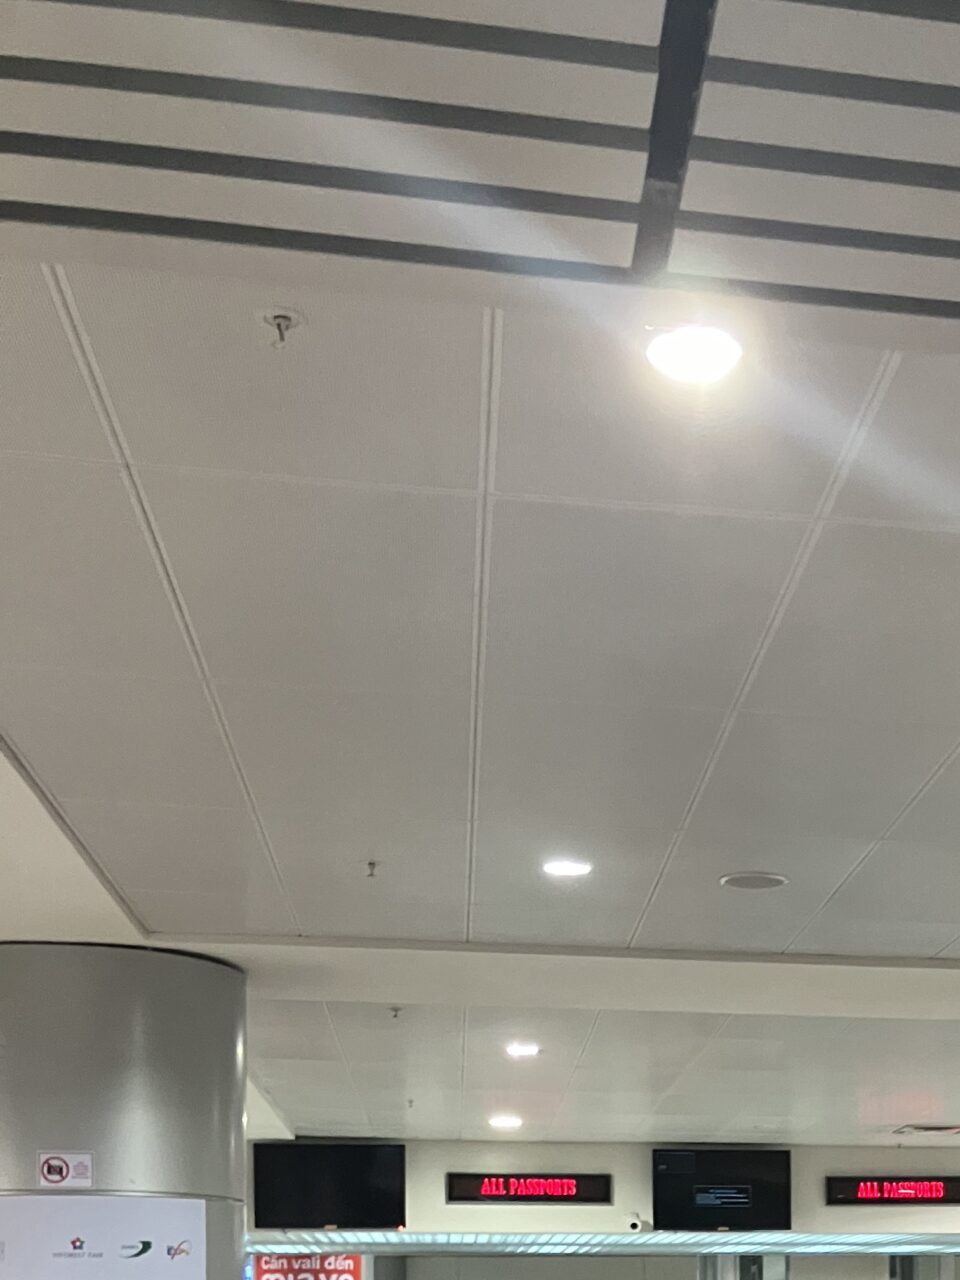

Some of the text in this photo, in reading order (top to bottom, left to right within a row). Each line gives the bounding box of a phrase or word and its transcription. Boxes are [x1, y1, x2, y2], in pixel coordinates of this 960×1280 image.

[480, 1178, 577, 1195] ALL PASSPORTS
[857, 1181, 944, 1198] ALL PASSPORTS
[292, 1256, 320, 1270] vali
